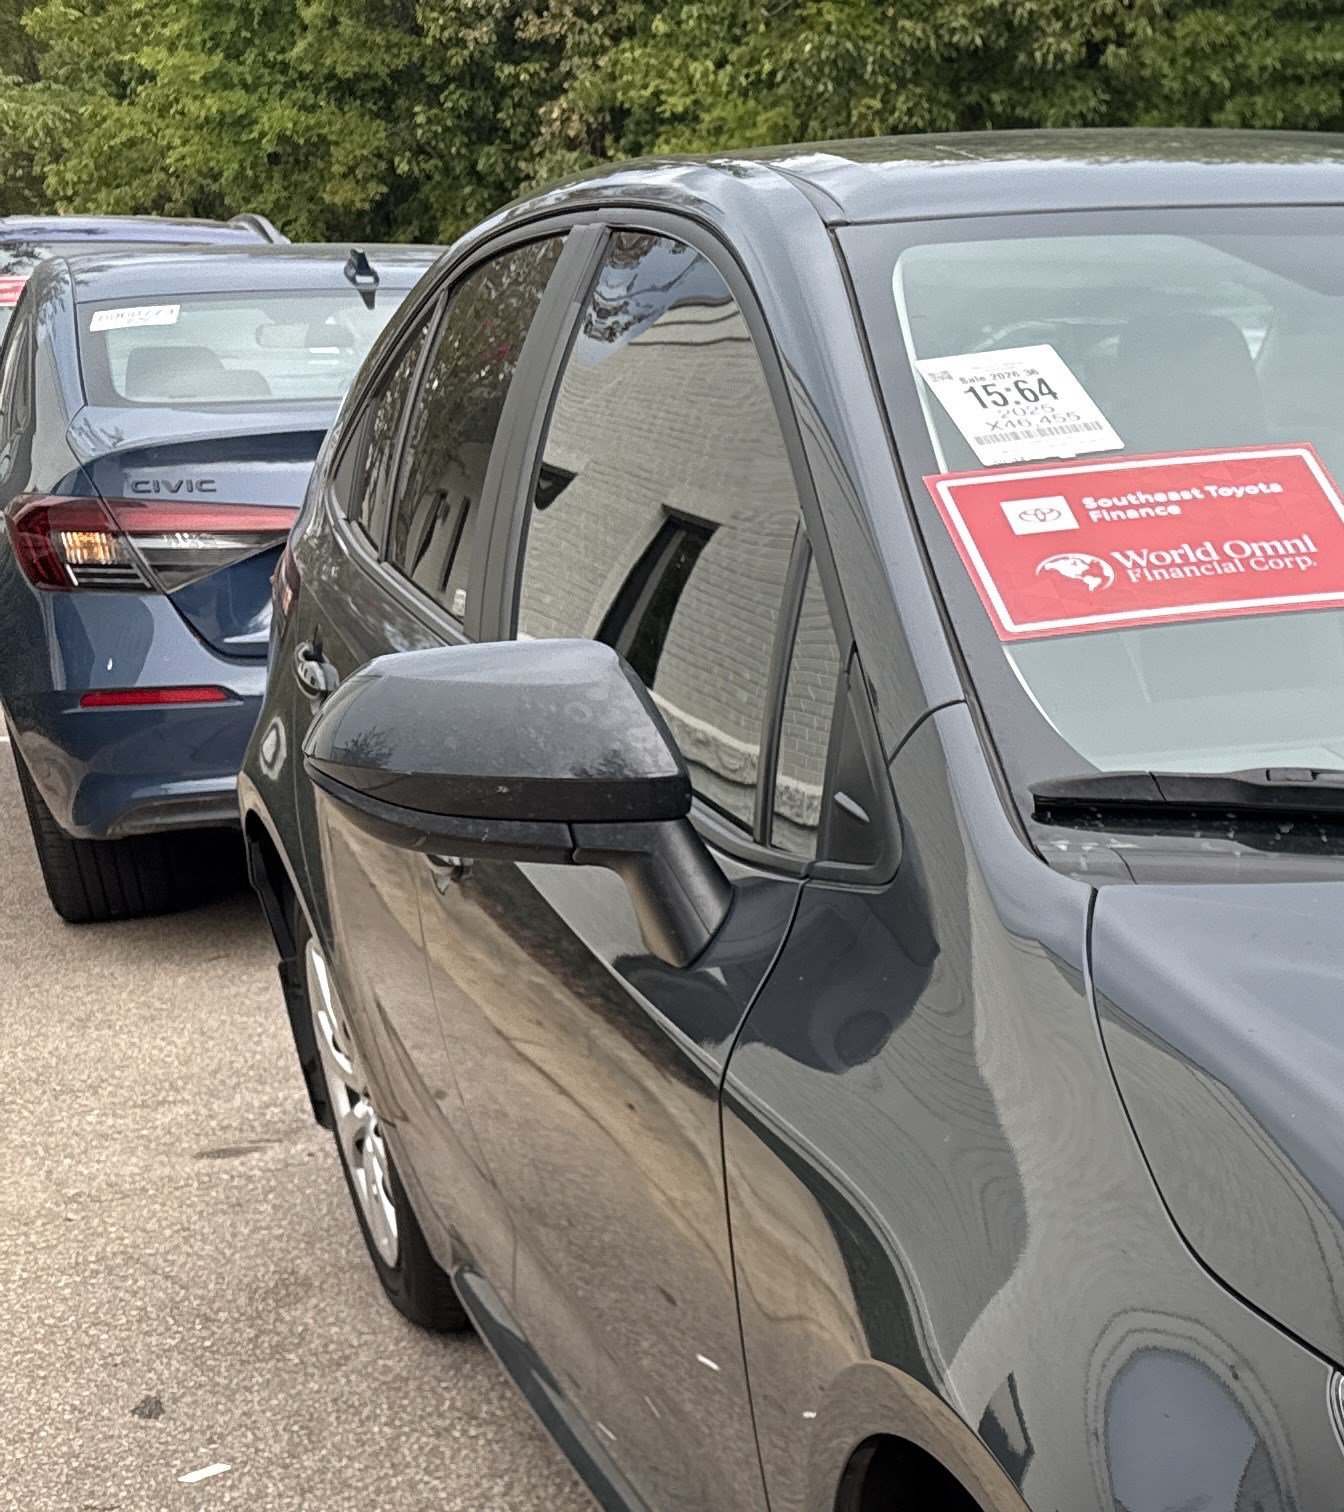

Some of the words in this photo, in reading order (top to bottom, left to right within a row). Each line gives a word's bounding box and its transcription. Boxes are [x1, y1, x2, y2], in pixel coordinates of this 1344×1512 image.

[964, 377, 1059, 409] 15:64
[130, 479, 217, 493] CIVIC
[1082, 487, 1204, 510] Southeast
[1204, 482, 1284, 499] Toyota
[1088, 504, 1182, 523] Finance
[1110, 541, 1220, 570] World
[1222, 534, 1319, 560] Omni
[1126, 558, 1245, 583] Financial
[1250, 554, 1318, 571] Corp.
